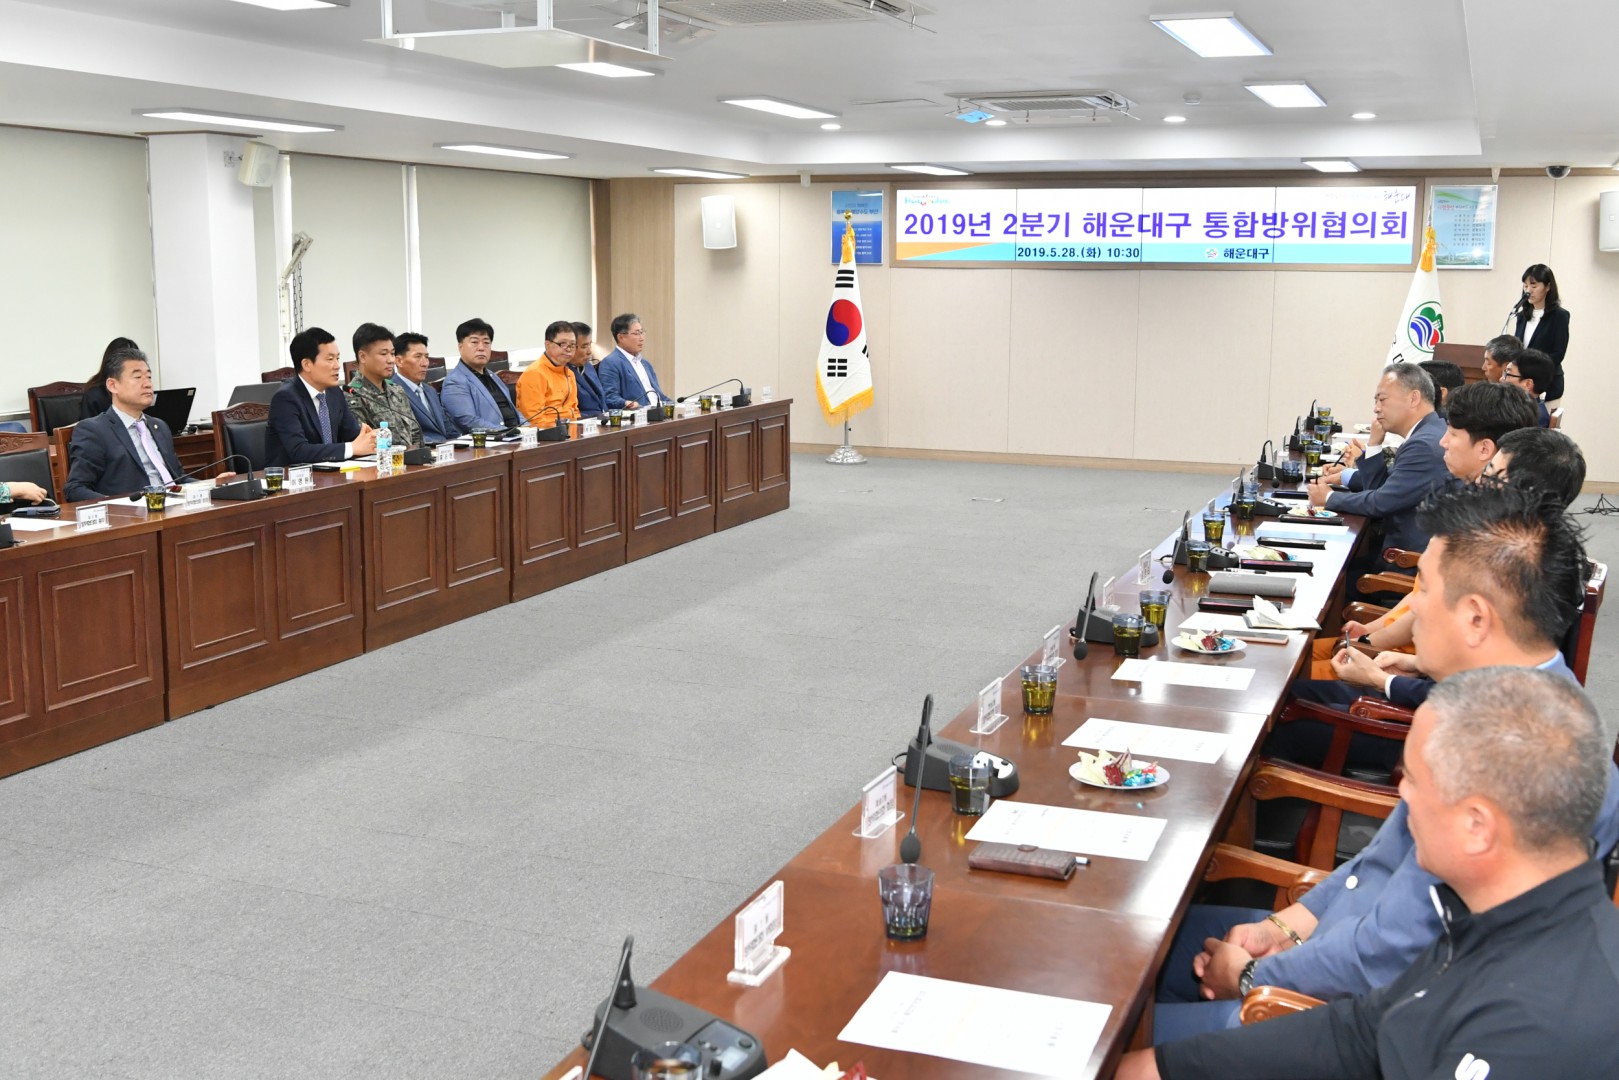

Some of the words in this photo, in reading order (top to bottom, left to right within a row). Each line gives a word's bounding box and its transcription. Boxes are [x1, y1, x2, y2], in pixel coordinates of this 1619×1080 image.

[905, 212, 991, 237] 2019년
[1003, 212, 1070, 238] 2분기
[1083, 212, 1192, 239] 해운대구
[1203, 211, 1407, 239] 통합방위협의회
[1017, 247, 1101, 260] 2019.5.28.(화)
[1107, 247, 1140, 259] 10:30
[1223, 248, 1270, 259] 해운대구
